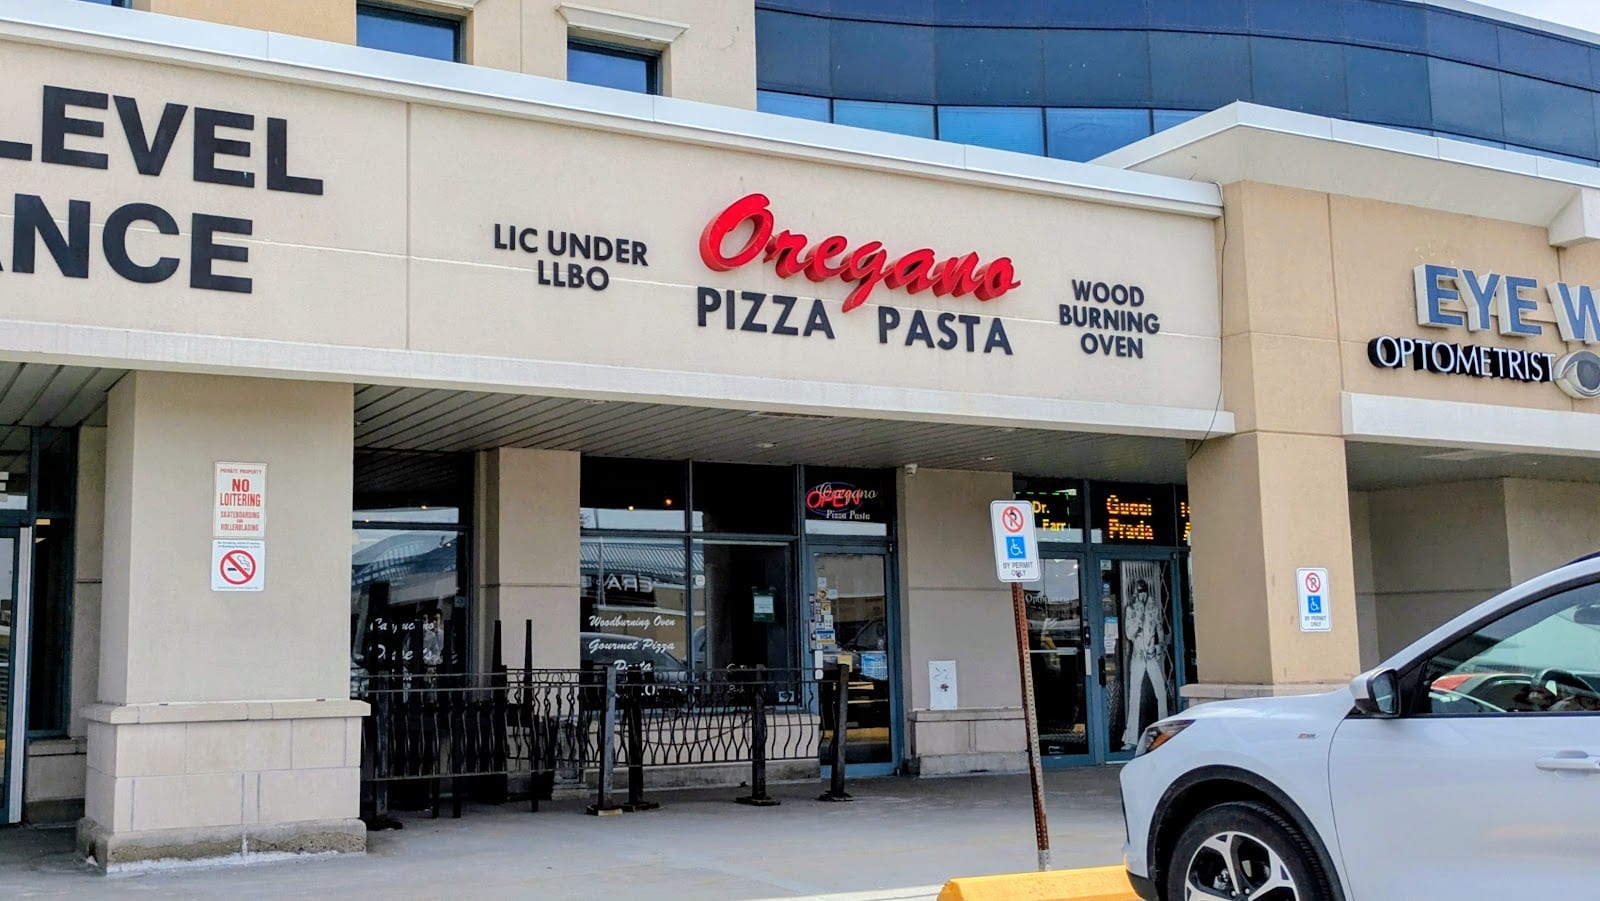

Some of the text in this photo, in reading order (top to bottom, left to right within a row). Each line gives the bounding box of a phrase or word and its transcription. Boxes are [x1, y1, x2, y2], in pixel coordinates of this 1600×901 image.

[0, 193, 253, 294] NCE
[494, 223, 648, 266] LIC UNDER
[699, 193, 1021, 312] Oregano
[537, 260, 610, 291] LLBO
[1071, 279, 1145, 307] WOOD
[1413, 263, 1543, 336] EYE
[697, 286, 1013, 355] PIZZA PASTA
[1059, 303, 1160, 334] BURNING
[1080, 333, 1143, 358] OVEN
[1368, 335, 1556, 382] OPTOMETRIST
[232, 479, 250, 492] NO
[220, 492, 261, 507] LOITERING
[806, 489, 862, 508] OPEN
[1032, 501, 1050, 514] Dr.
[826, 509, 871, 520] Pizza Pasta
[1109, 519, 1154, 540] Prada
[1003, 561, 1033, 569] BY PERMIT
[589, 615, 676, 630] Woodburning Oven
[588, 638, 675, 654] Gourmet Pizza
